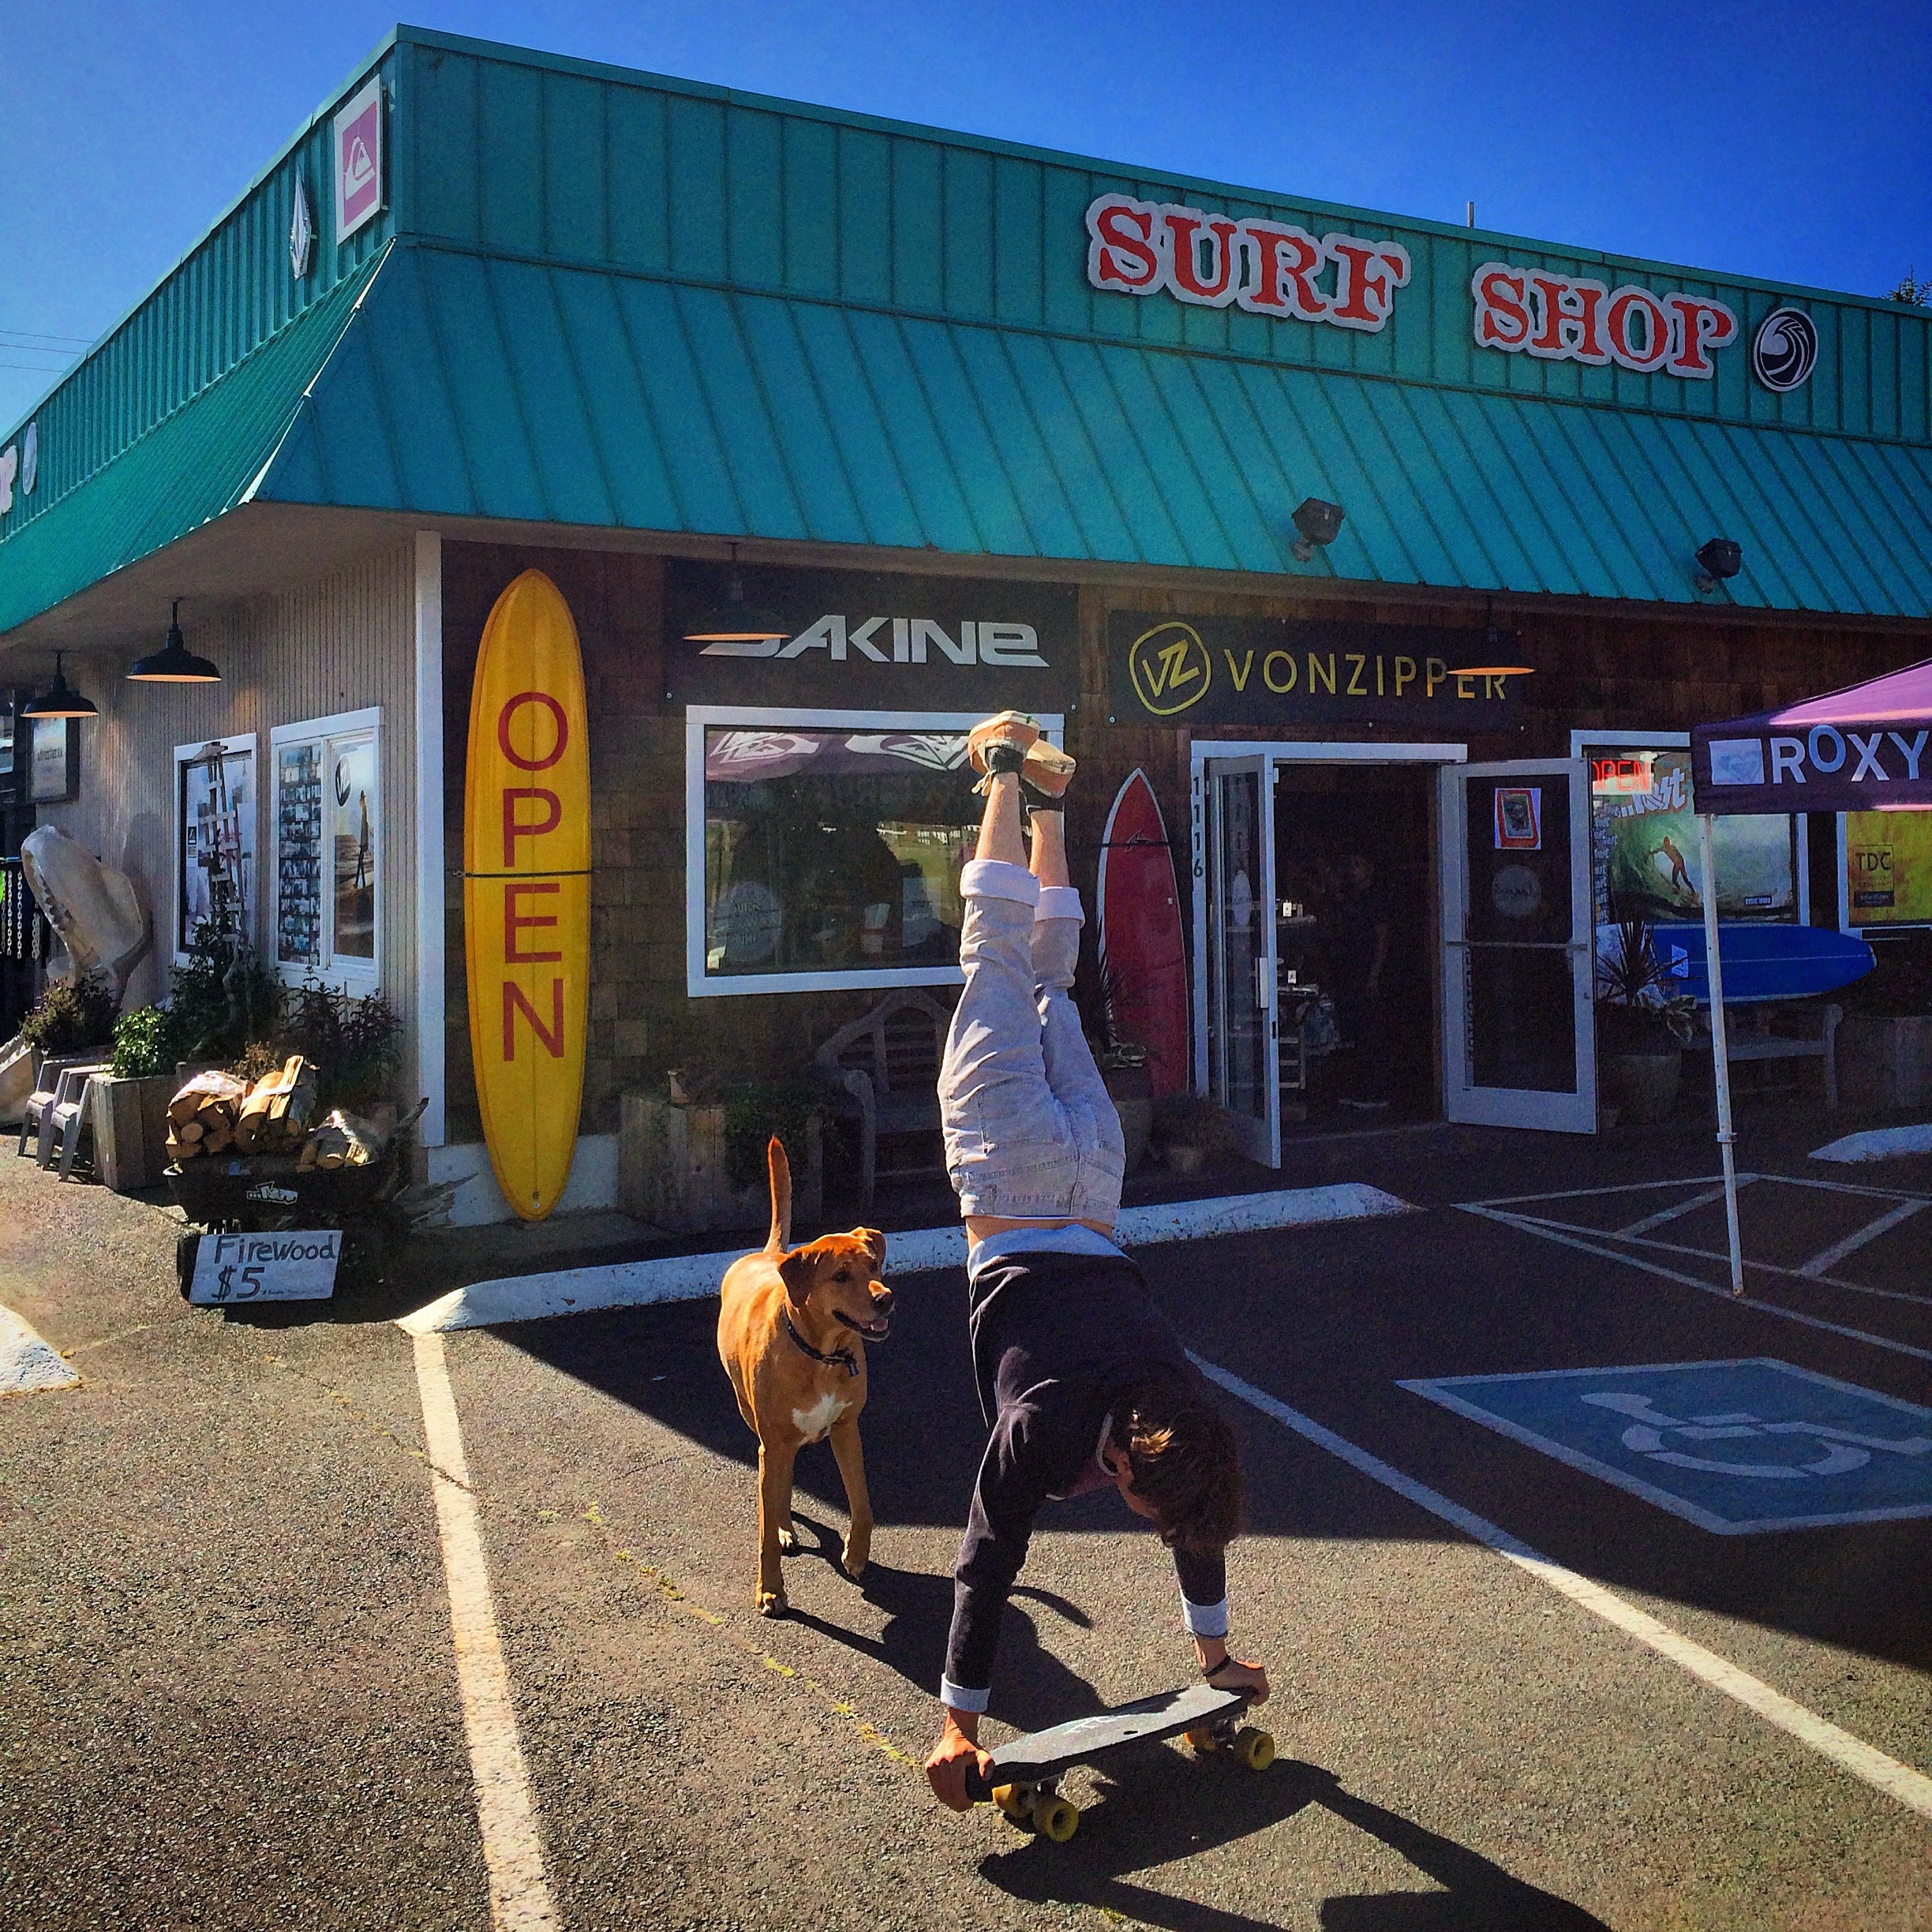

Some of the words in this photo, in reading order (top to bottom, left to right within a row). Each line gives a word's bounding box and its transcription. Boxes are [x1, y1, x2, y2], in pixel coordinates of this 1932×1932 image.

[1097, 204, 1403, 324] SURF
[1480, 271, 1734, 373] SHOP
[1141, 639, 1200, 698] VZ
[1769, 724, 1930, 785] ROXY
[1193, 776, 1204, 878] 1116
[497, 691, 569, 1061] OPEN
[1855, 852, 1892, 872] TDC
[211, 1264, 266, 1302] $5
